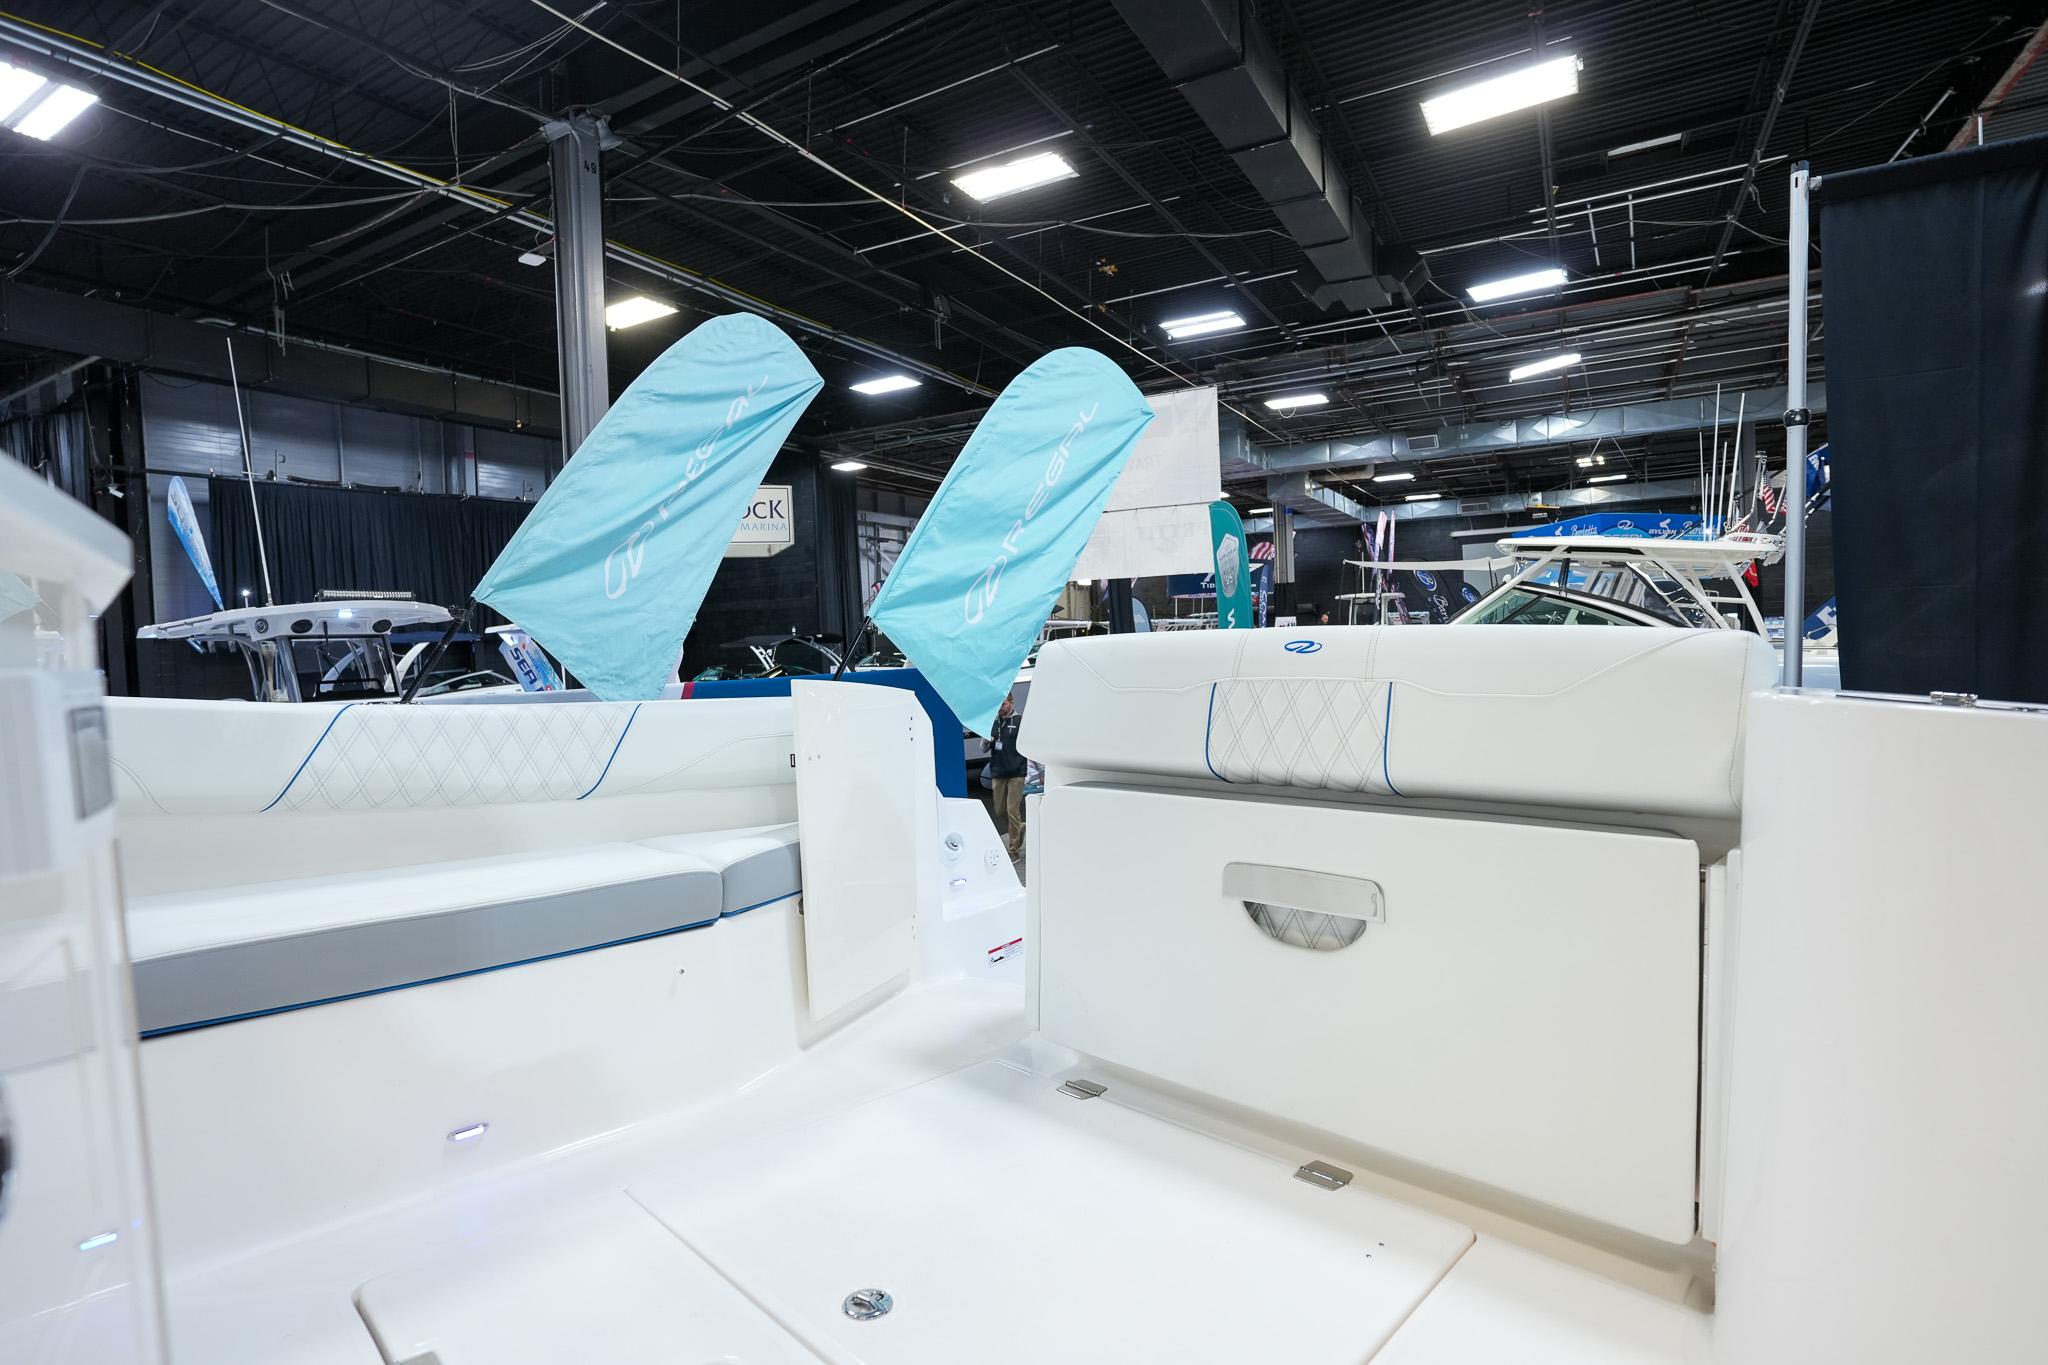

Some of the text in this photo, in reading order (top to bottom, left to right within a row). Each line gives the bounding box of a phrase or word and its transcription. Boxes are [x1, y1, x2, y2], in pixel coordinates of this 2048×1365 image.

[583, 160, 598, 175] 49
[1001, 402, 1099, 555] REGAL
[740, 523, 787, 532] MARINA
[510, 647, 538, 685] SEA
